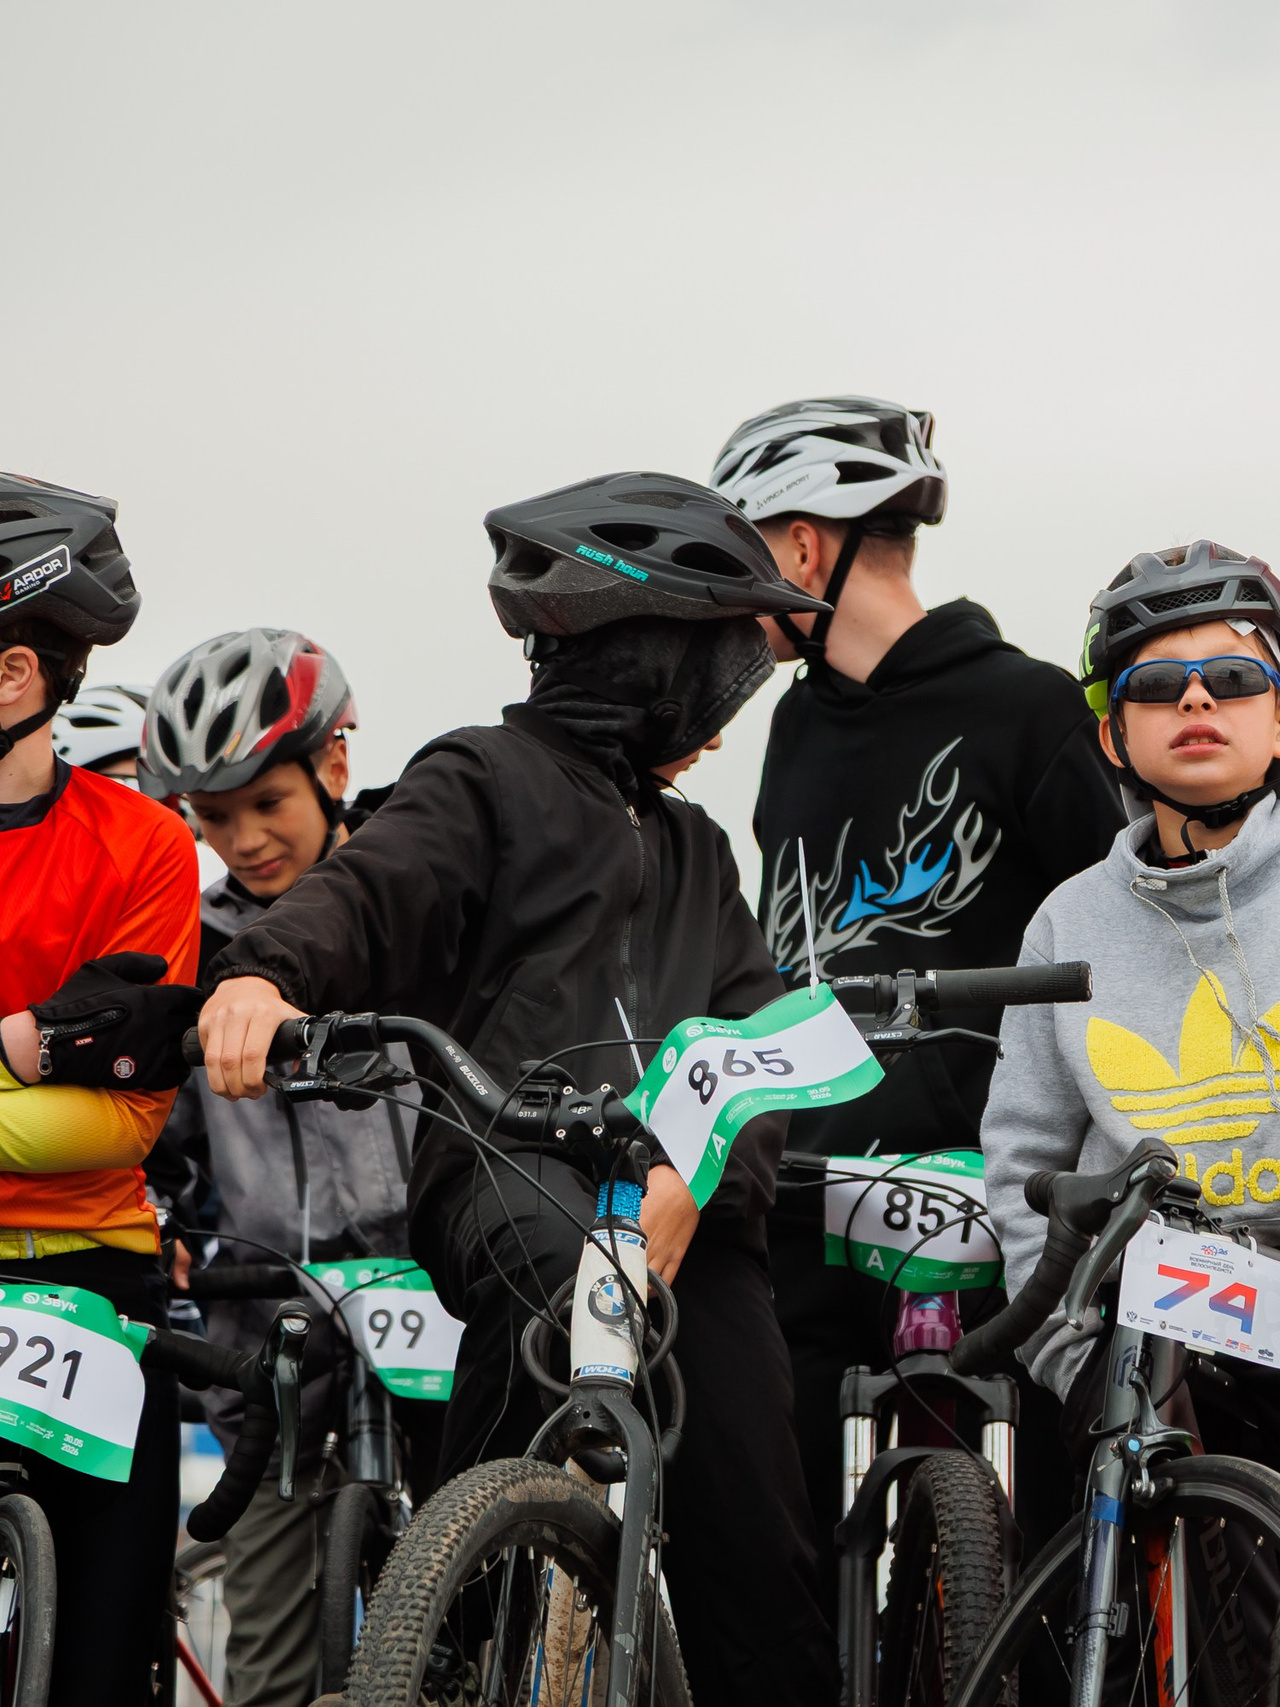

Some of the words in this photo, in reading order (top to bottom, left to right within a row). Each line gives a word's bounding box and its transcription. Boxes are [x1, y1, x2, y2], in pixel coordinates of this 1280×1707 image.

[763, 488, 785, 504] VINCA
[786, 474, 810, 491] SPORT
[14, 558, 63, 591] ARDOR
[15, 580, 41, 595] GAMING
[705, 1023, 742, 1036] Звук
[459, 1065, 489, 1096] BUCKLOS
[688, 1047, 795, 1105] 865
[933, 1154, 966, 1168] Звук
[883, 1187, 976, 1244] 851
[41, 1293, 78, 1313] Звук
[1154, 1263, 1258, 1335] 74
[368, 1309, 426, 1349] 99
[0, 1326, 83, 1400] 921
[584, 1365, 627, 1375] WOLF
